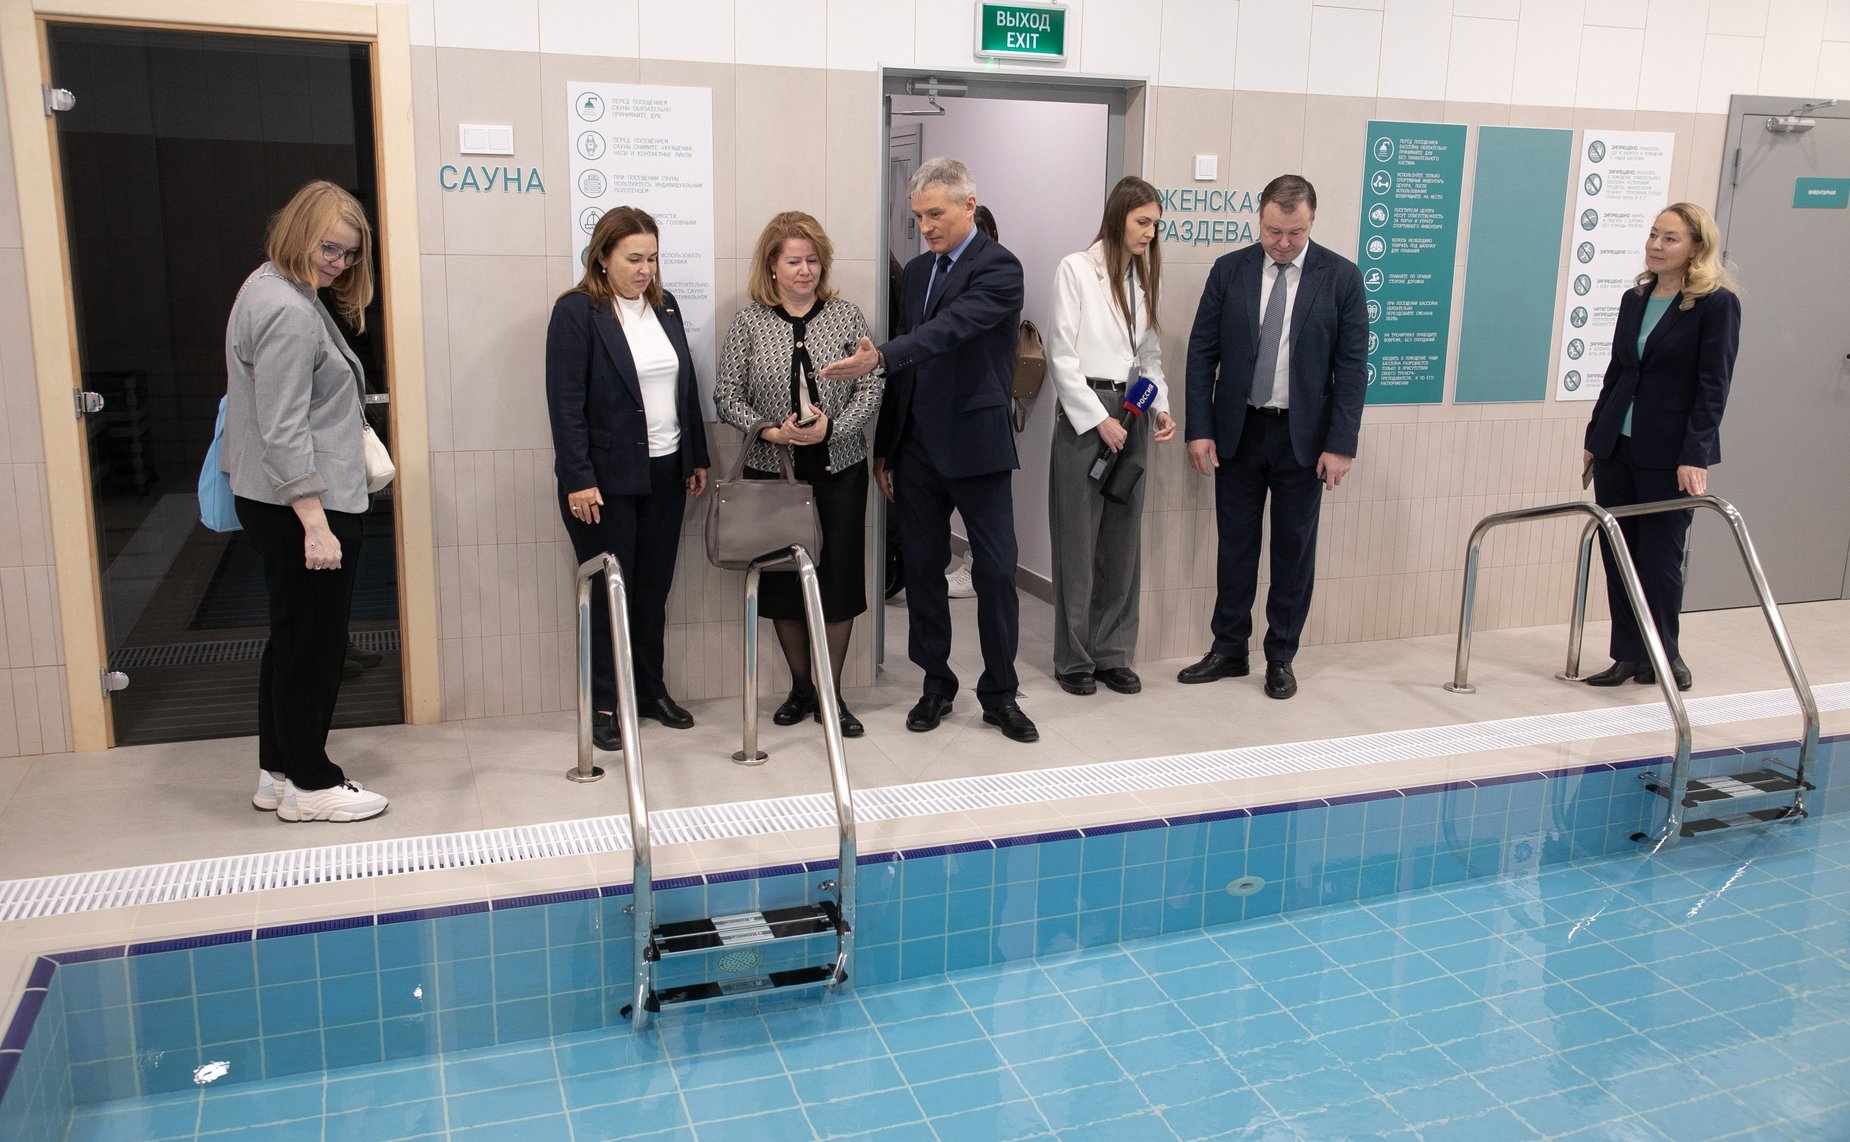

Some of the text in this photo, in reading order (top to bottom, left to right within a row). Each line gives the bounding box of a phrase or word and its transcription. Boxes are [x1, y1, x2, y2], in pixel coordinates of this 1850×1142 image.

[996, 10, 1050, 32] ВЫХОД
[1007, 32, 1040, 48] EXIT
[438, 164, 546, 194] САУНА
[1158, 219, 1260, 246] РАЗДЕВА
[1136, 384, 1154, 408] РОССИЯ
